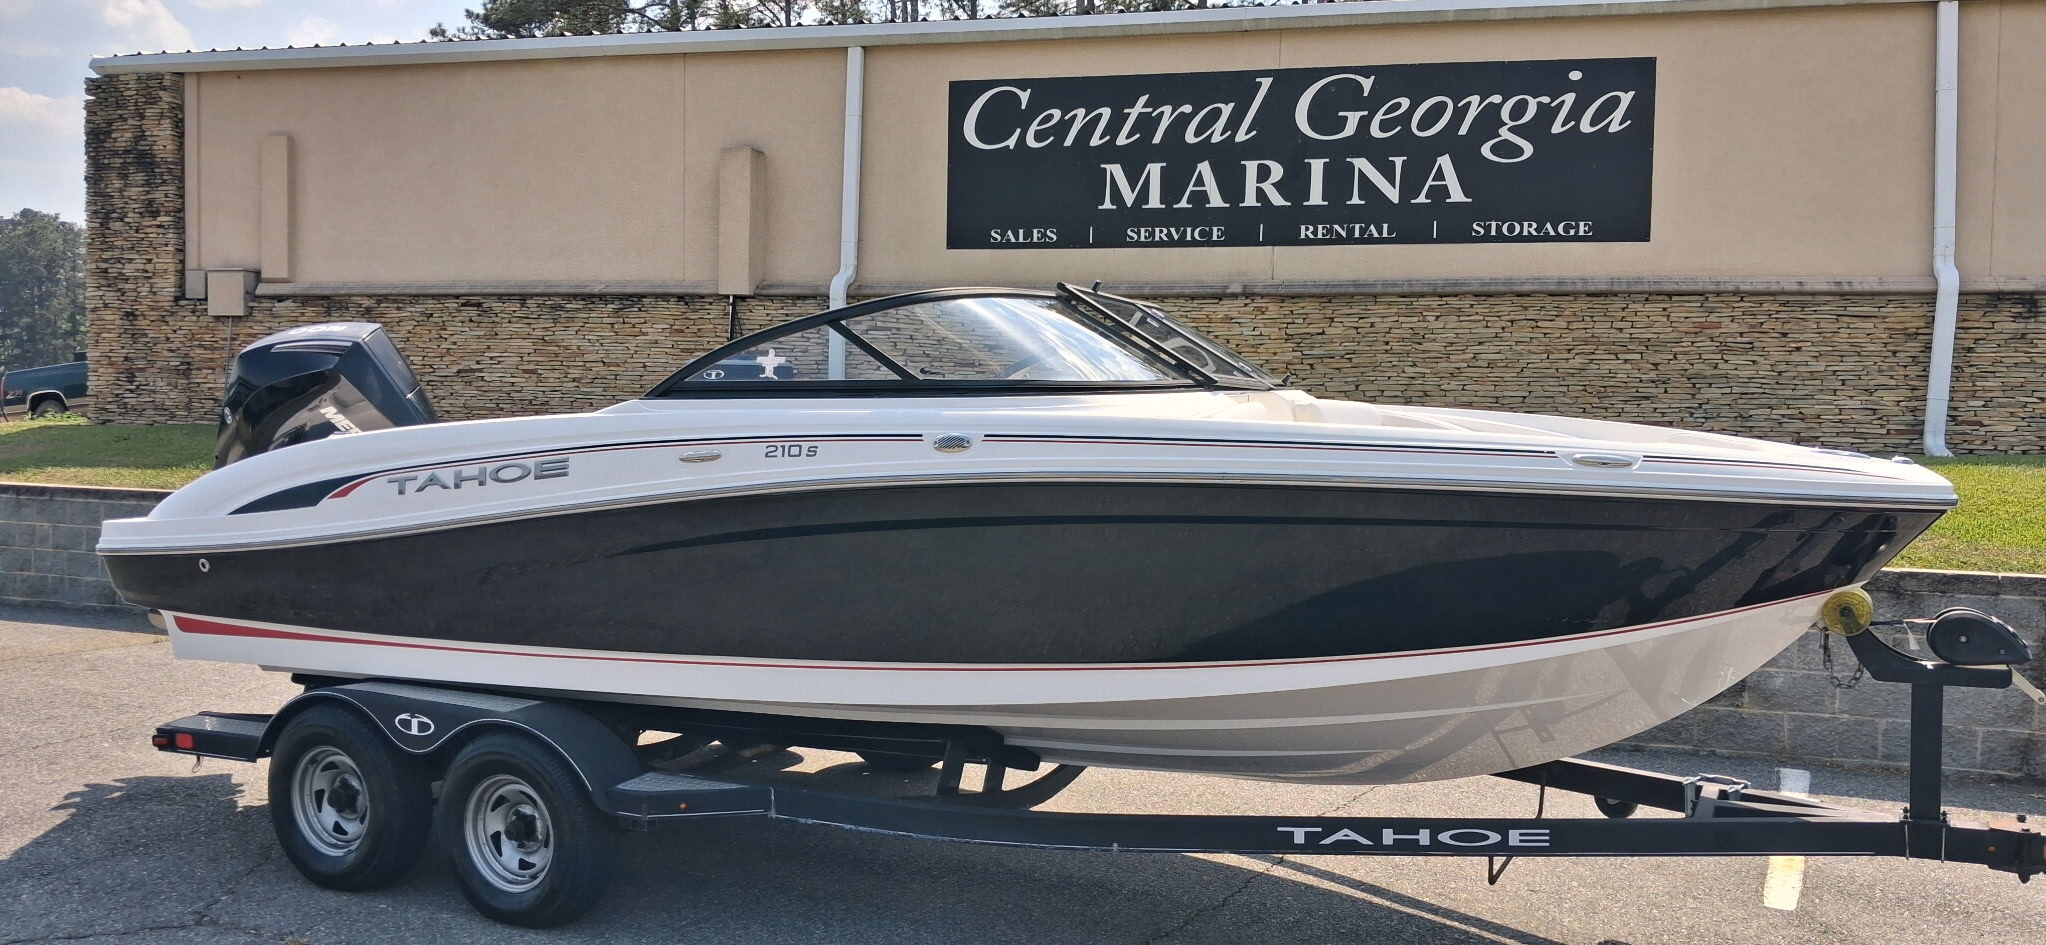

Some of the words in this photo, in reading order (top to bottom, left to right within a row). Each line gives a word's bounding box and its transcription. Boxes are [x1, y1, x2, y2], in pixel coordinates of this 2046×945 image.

[963, 77, 1273, 149] Central
[1294, 71, 1636, 162] Georgia
[1097, 154, 1473, 209] MARINA
[990, 228, 1057, 243] SALES
[1126, 226, 1225, 242] SERVICE
[1299, 223, 1397, 239] RENTAL
[1471, 220, 1593, 237] STORAGE
[387, 456, 570, 496] TAHOE
[1276, 826, 1550, 847] TAHOE
